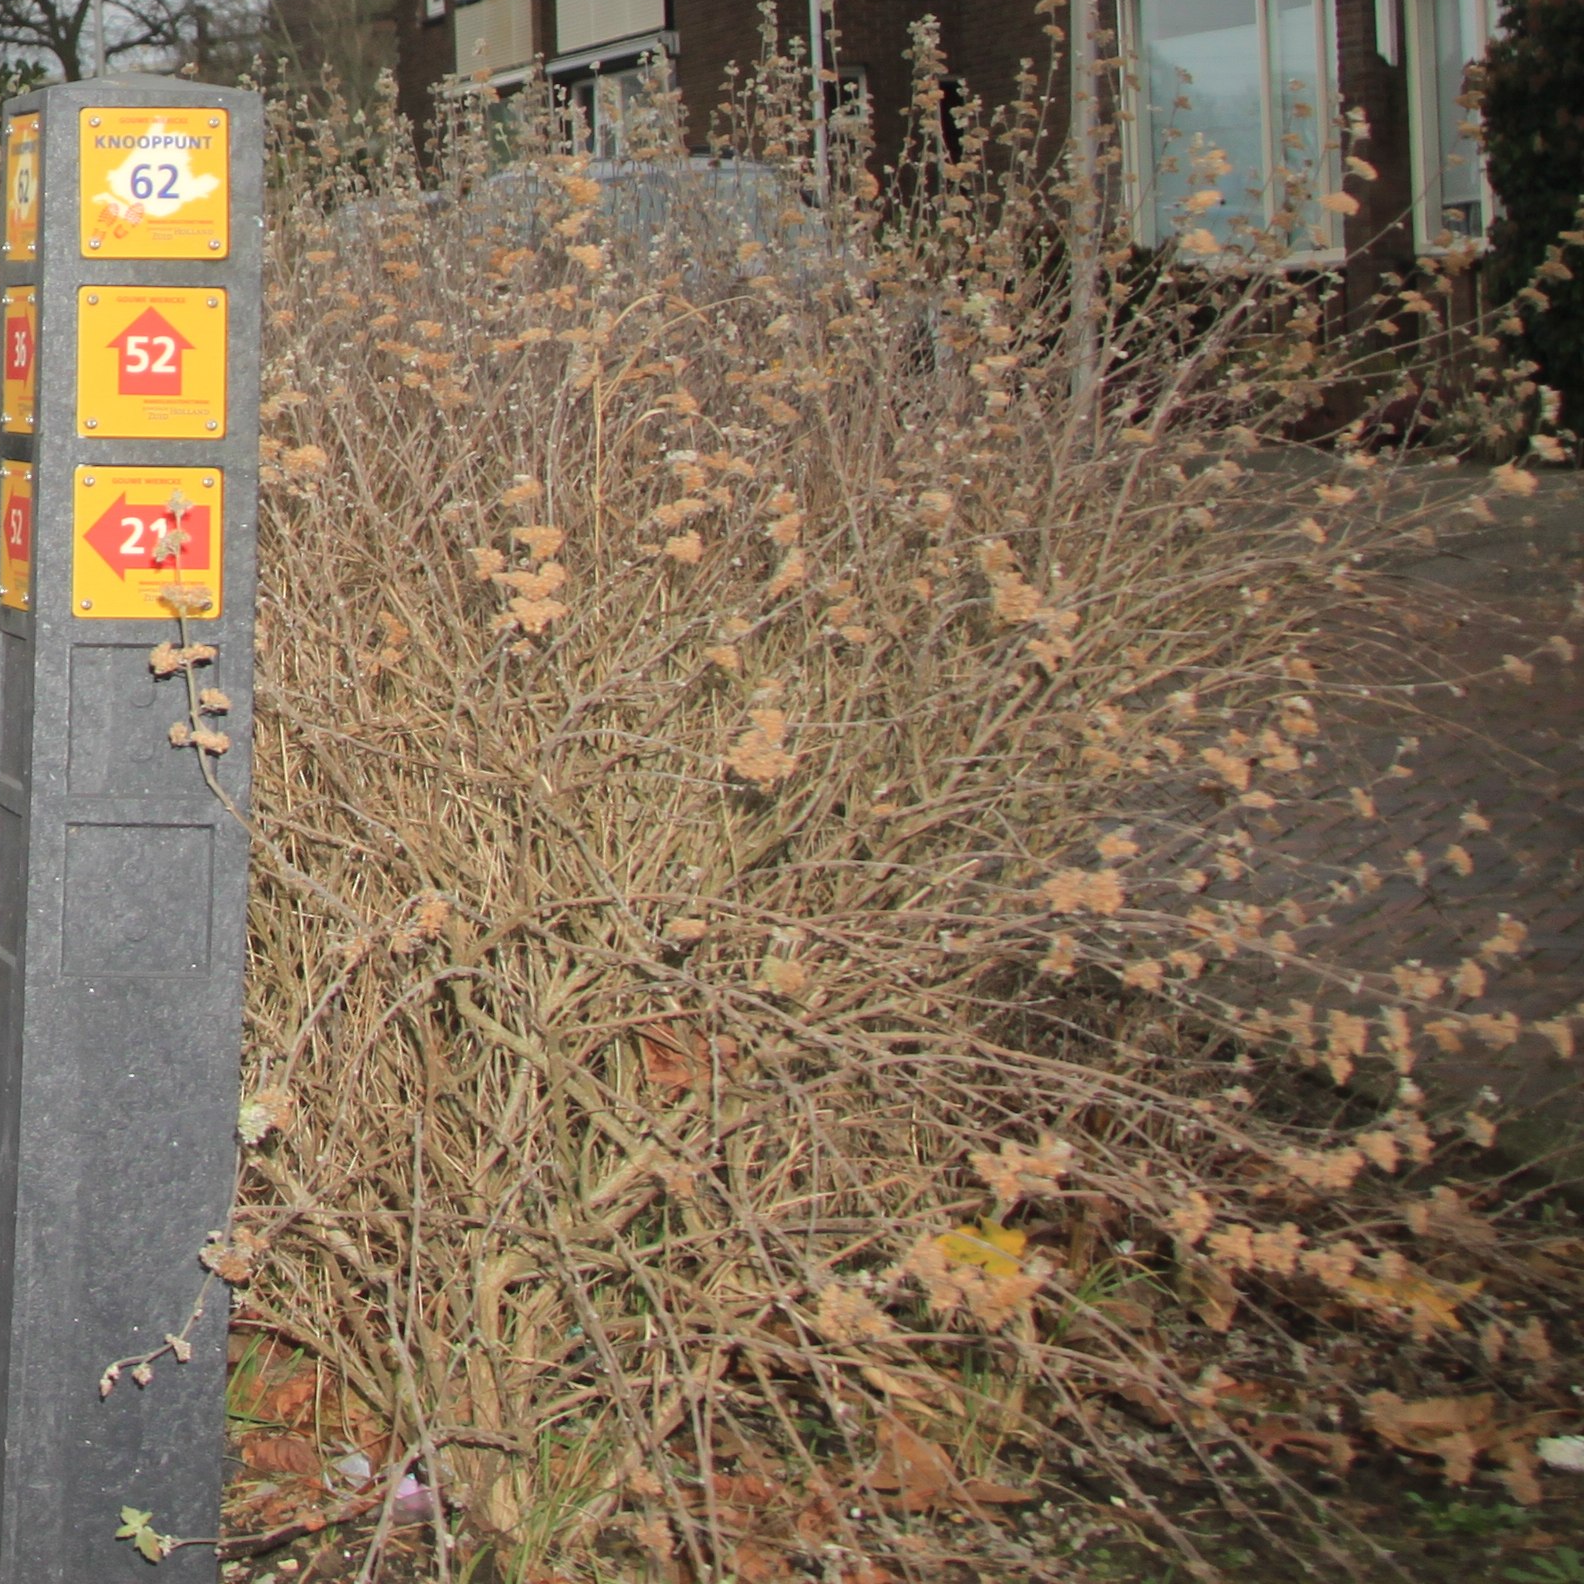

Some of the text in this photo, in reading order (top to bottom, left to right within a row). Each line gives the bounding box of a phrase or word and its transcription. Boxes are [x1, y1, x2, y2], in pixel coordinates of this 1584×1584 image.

[95, 135, 212, 149] KNOOPPUNT
[18, 168, 30, 204] 62
[130, 163, 180, 199] 62
[14, 331, 27, 367] 36
[125, 335, 177, 373] 52
[11, 508, 23, 545] 52
